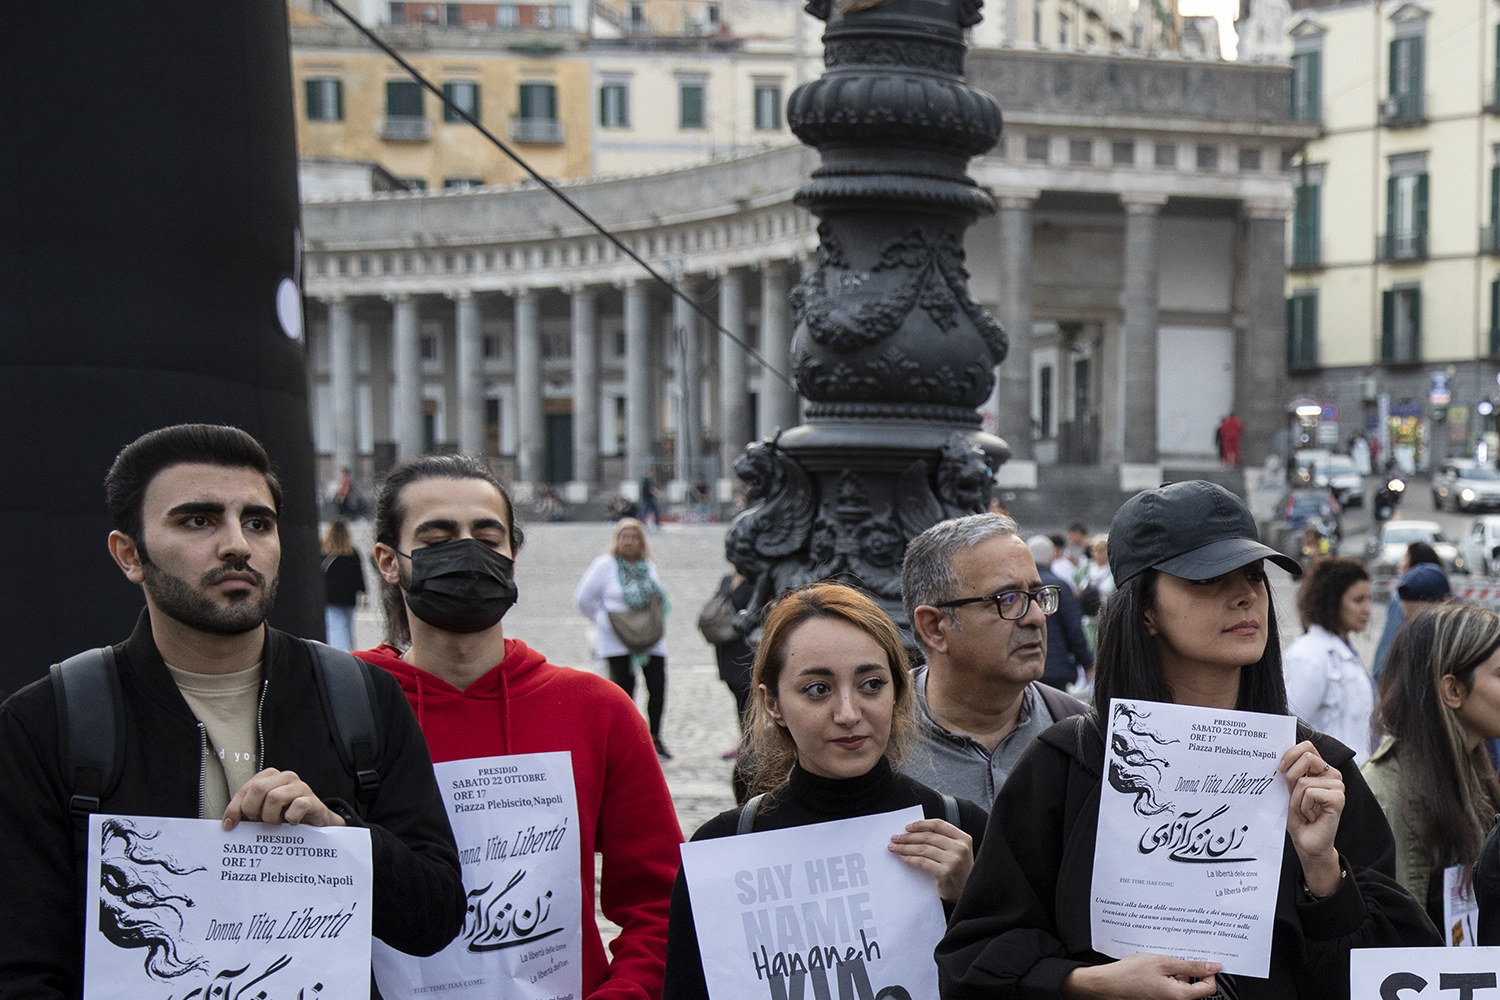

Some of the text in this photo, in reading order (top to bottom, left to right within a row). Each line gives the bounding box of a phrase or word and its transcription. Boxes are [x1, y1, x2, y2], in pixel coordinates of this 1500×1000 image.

[1192, 723, 1267, 738] SABATO 22 OTTOBRE
[1214, 719, 1246, 728] PRESIDIO
[1190, 733, 1206, 741] ORE
[479, 765, 517, 775] PRESIDIO
[453, 772, 546, 789] SABATO 22 OTTOBRE
[454, 789, 486, 800] ORE 17
[256, 834, 304, 844] PRESIDIO
[223, 843, 337, 857] SABATO 22 OTTOBRE
[459, 846, 481, 868] onna,
[222, 856, 261, 867] ORE 17
[734, 853, 869, 905] SAY HER
[205, 919, 243, 944] Donna,
[741, 892, 878, 960] NAME
[752, 929, 882, 980] Hananeh
